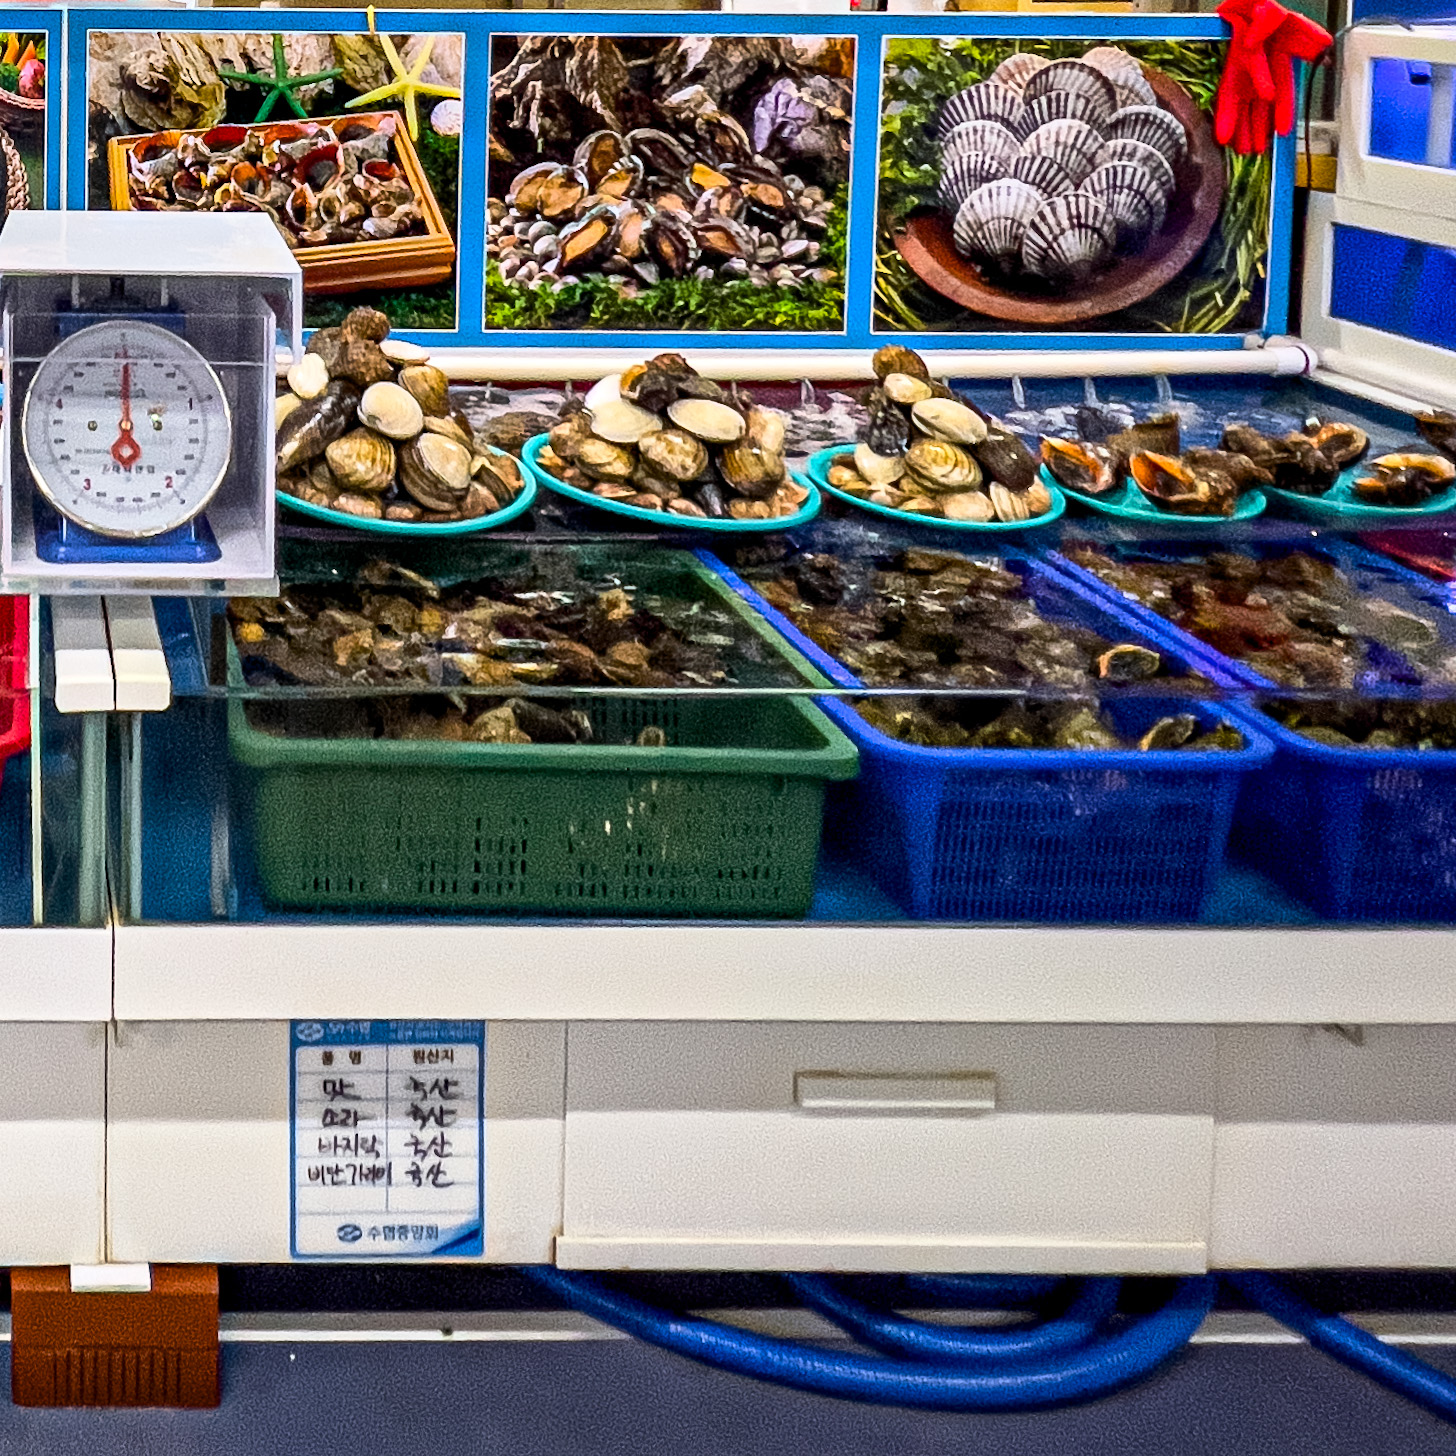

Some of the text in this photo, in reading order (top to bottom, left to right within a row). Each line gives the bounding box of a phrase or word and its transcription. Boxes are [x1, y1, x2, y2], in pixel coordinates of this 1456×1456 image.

[83, 478, 91, 490] 3
[164, 475, 173, 489] 2
[413, 1048, 454, 1065] 원산지
[404, 1075, 463, 1101] 국산
[322, 1102, 458, 1131] 소라 국산
[318, 1130, 453, 1162] 바지락 국산
[405, 1160, 454, 1187] 국산
[367, 1224, 439, 1242] 수협중앙회
